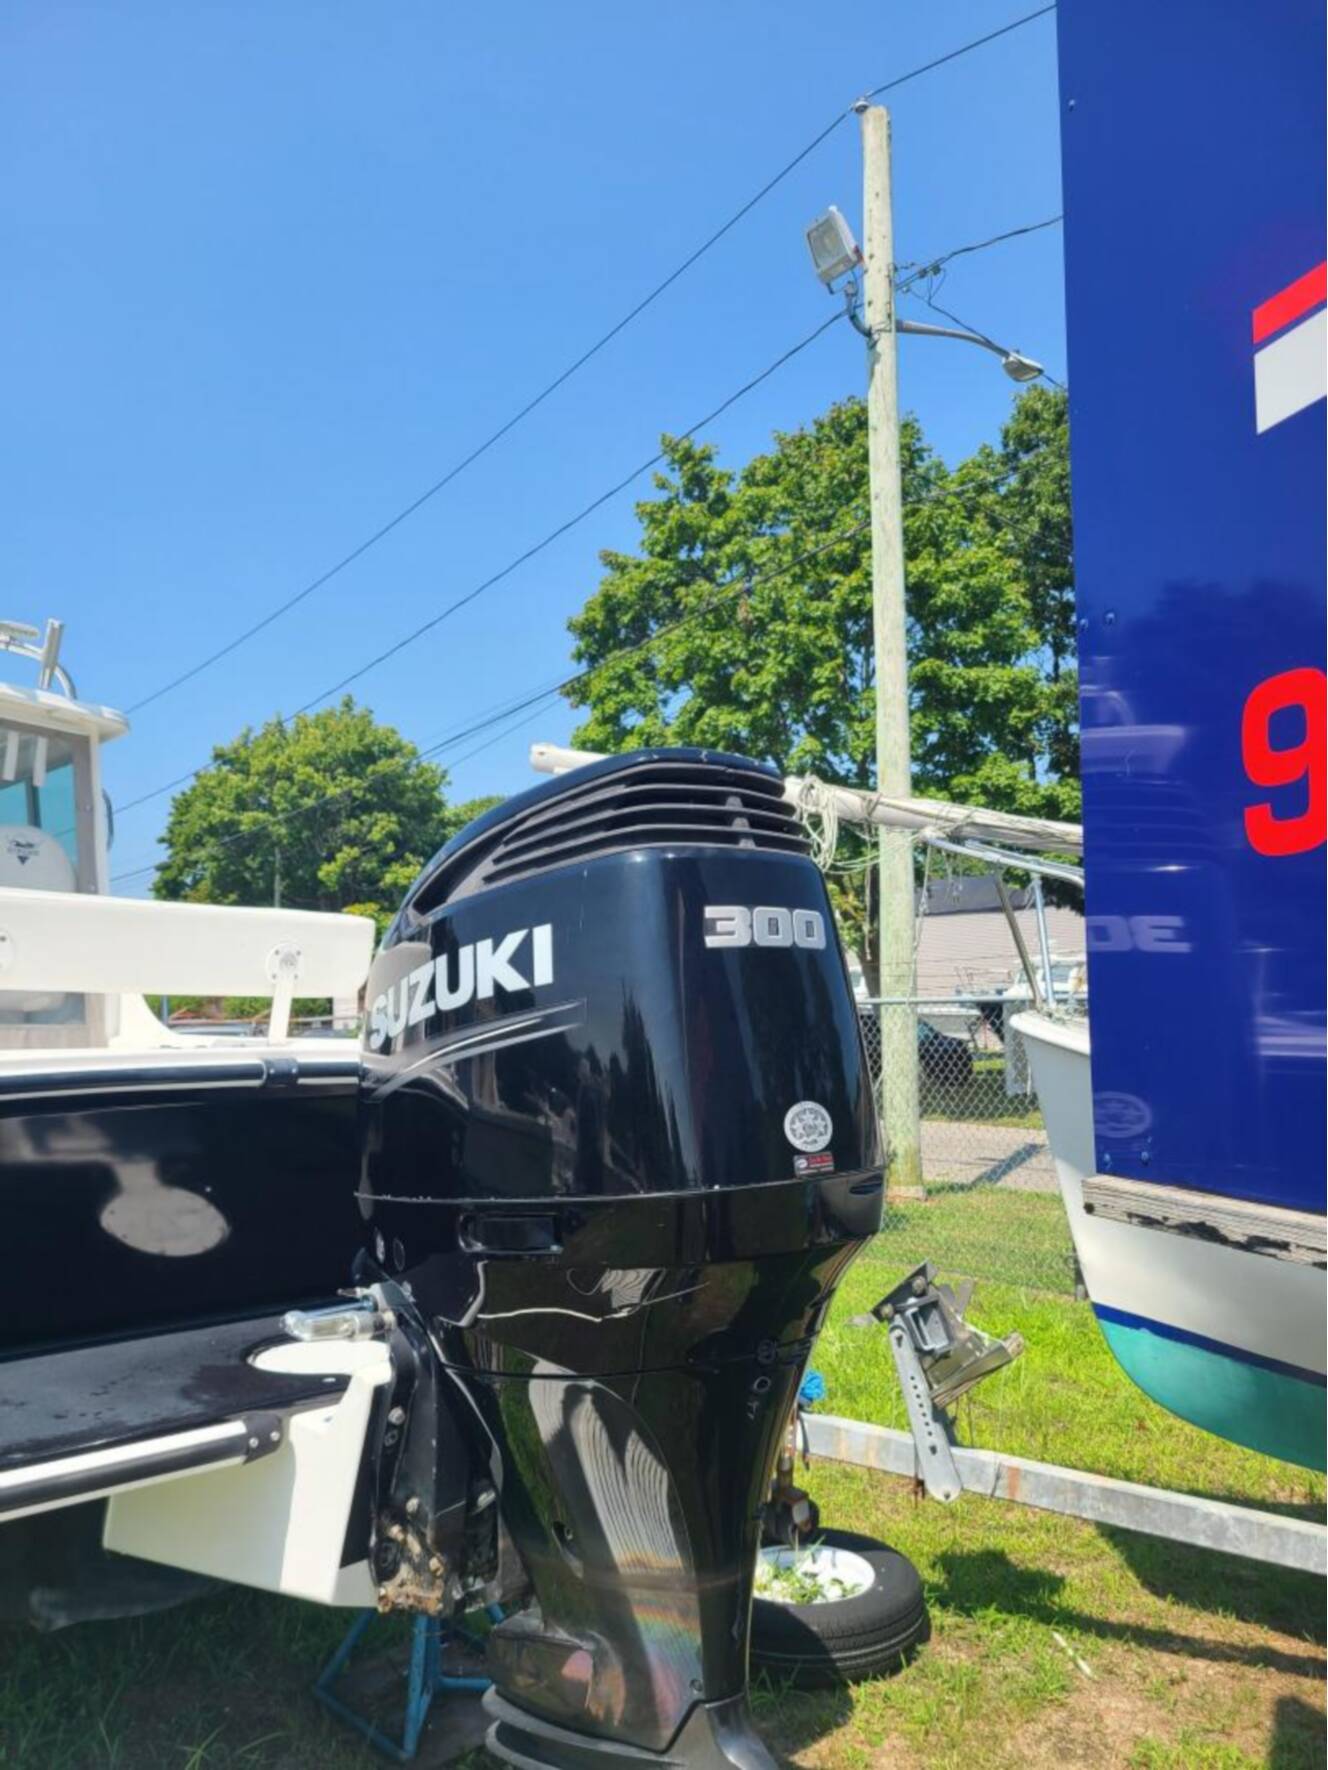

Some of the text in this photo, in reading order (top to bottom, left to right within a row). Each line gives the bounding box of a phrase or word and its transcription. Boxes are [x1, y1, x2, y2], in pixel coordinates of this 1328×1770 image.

[1242, 667, 1328, 857] 9
[369, 923, 554, 1050] SUZUKI
[704, 906, 826, 949] 300
